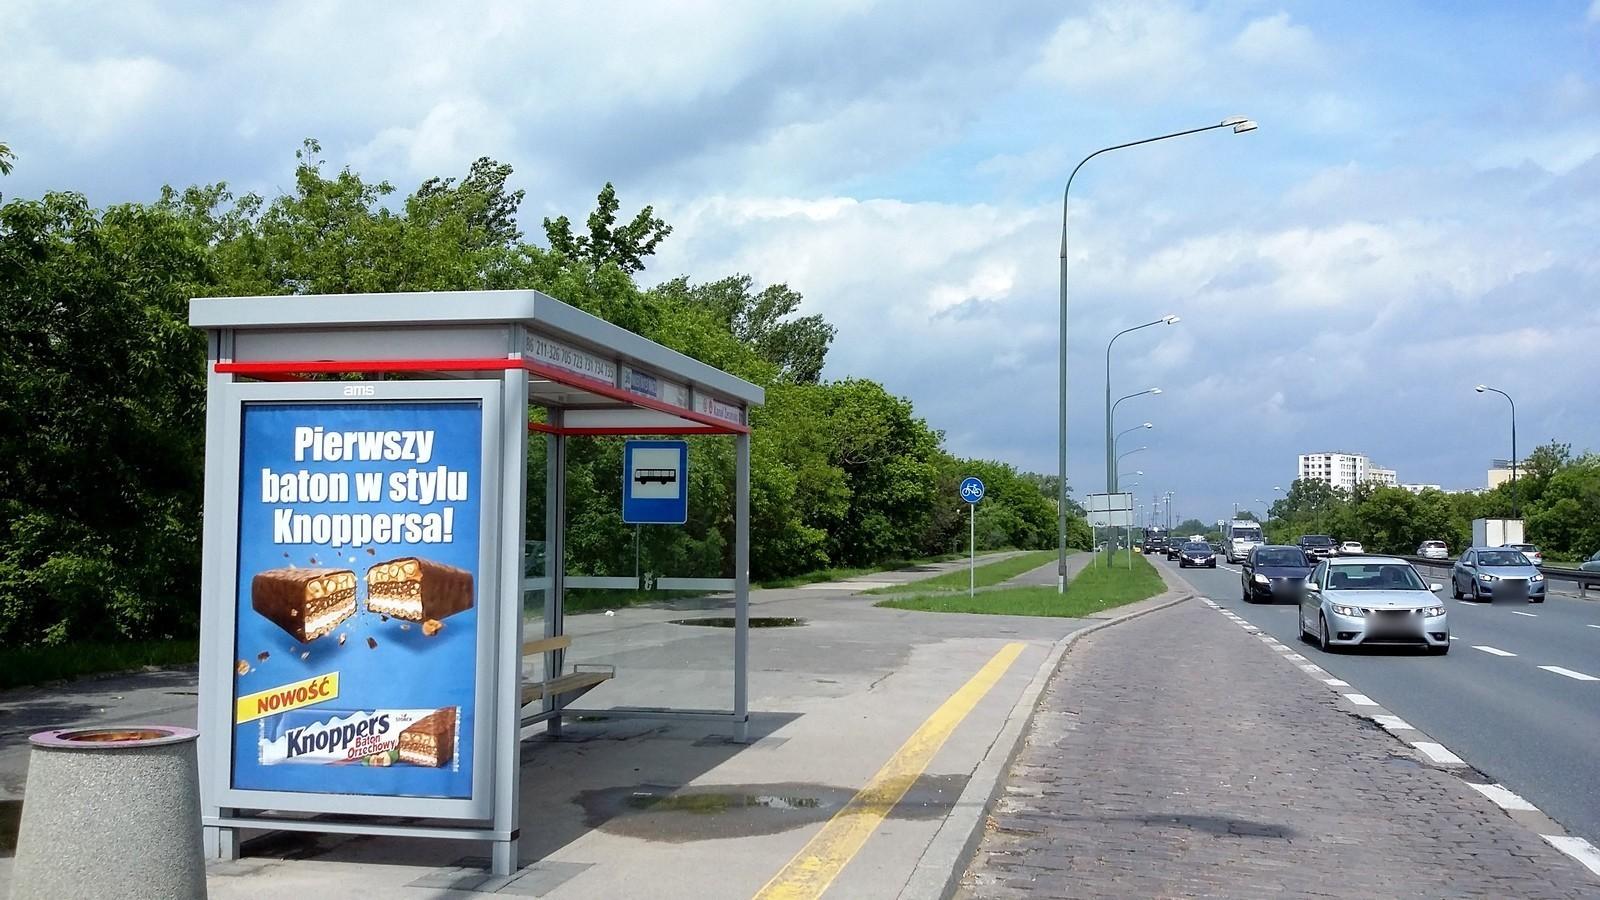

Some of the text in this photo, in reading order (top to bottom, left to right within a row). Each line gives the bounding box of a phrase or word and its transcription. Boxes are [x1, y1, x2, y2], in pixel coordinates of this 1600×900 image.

[343, 385, 375, 396] ams
[294, 426, 435, 463] Pierwszy
[261, 465, 468, 505] baton w stylu
[273, 507, 455, 548] Knoppersa!
[257, 676, 330, 714] NOWOŚĆ
[286, 713, 390, 758] Knoppers
[347, 739, 397, 759] Orzechowy
[354, 734, 382, 748] Baton
